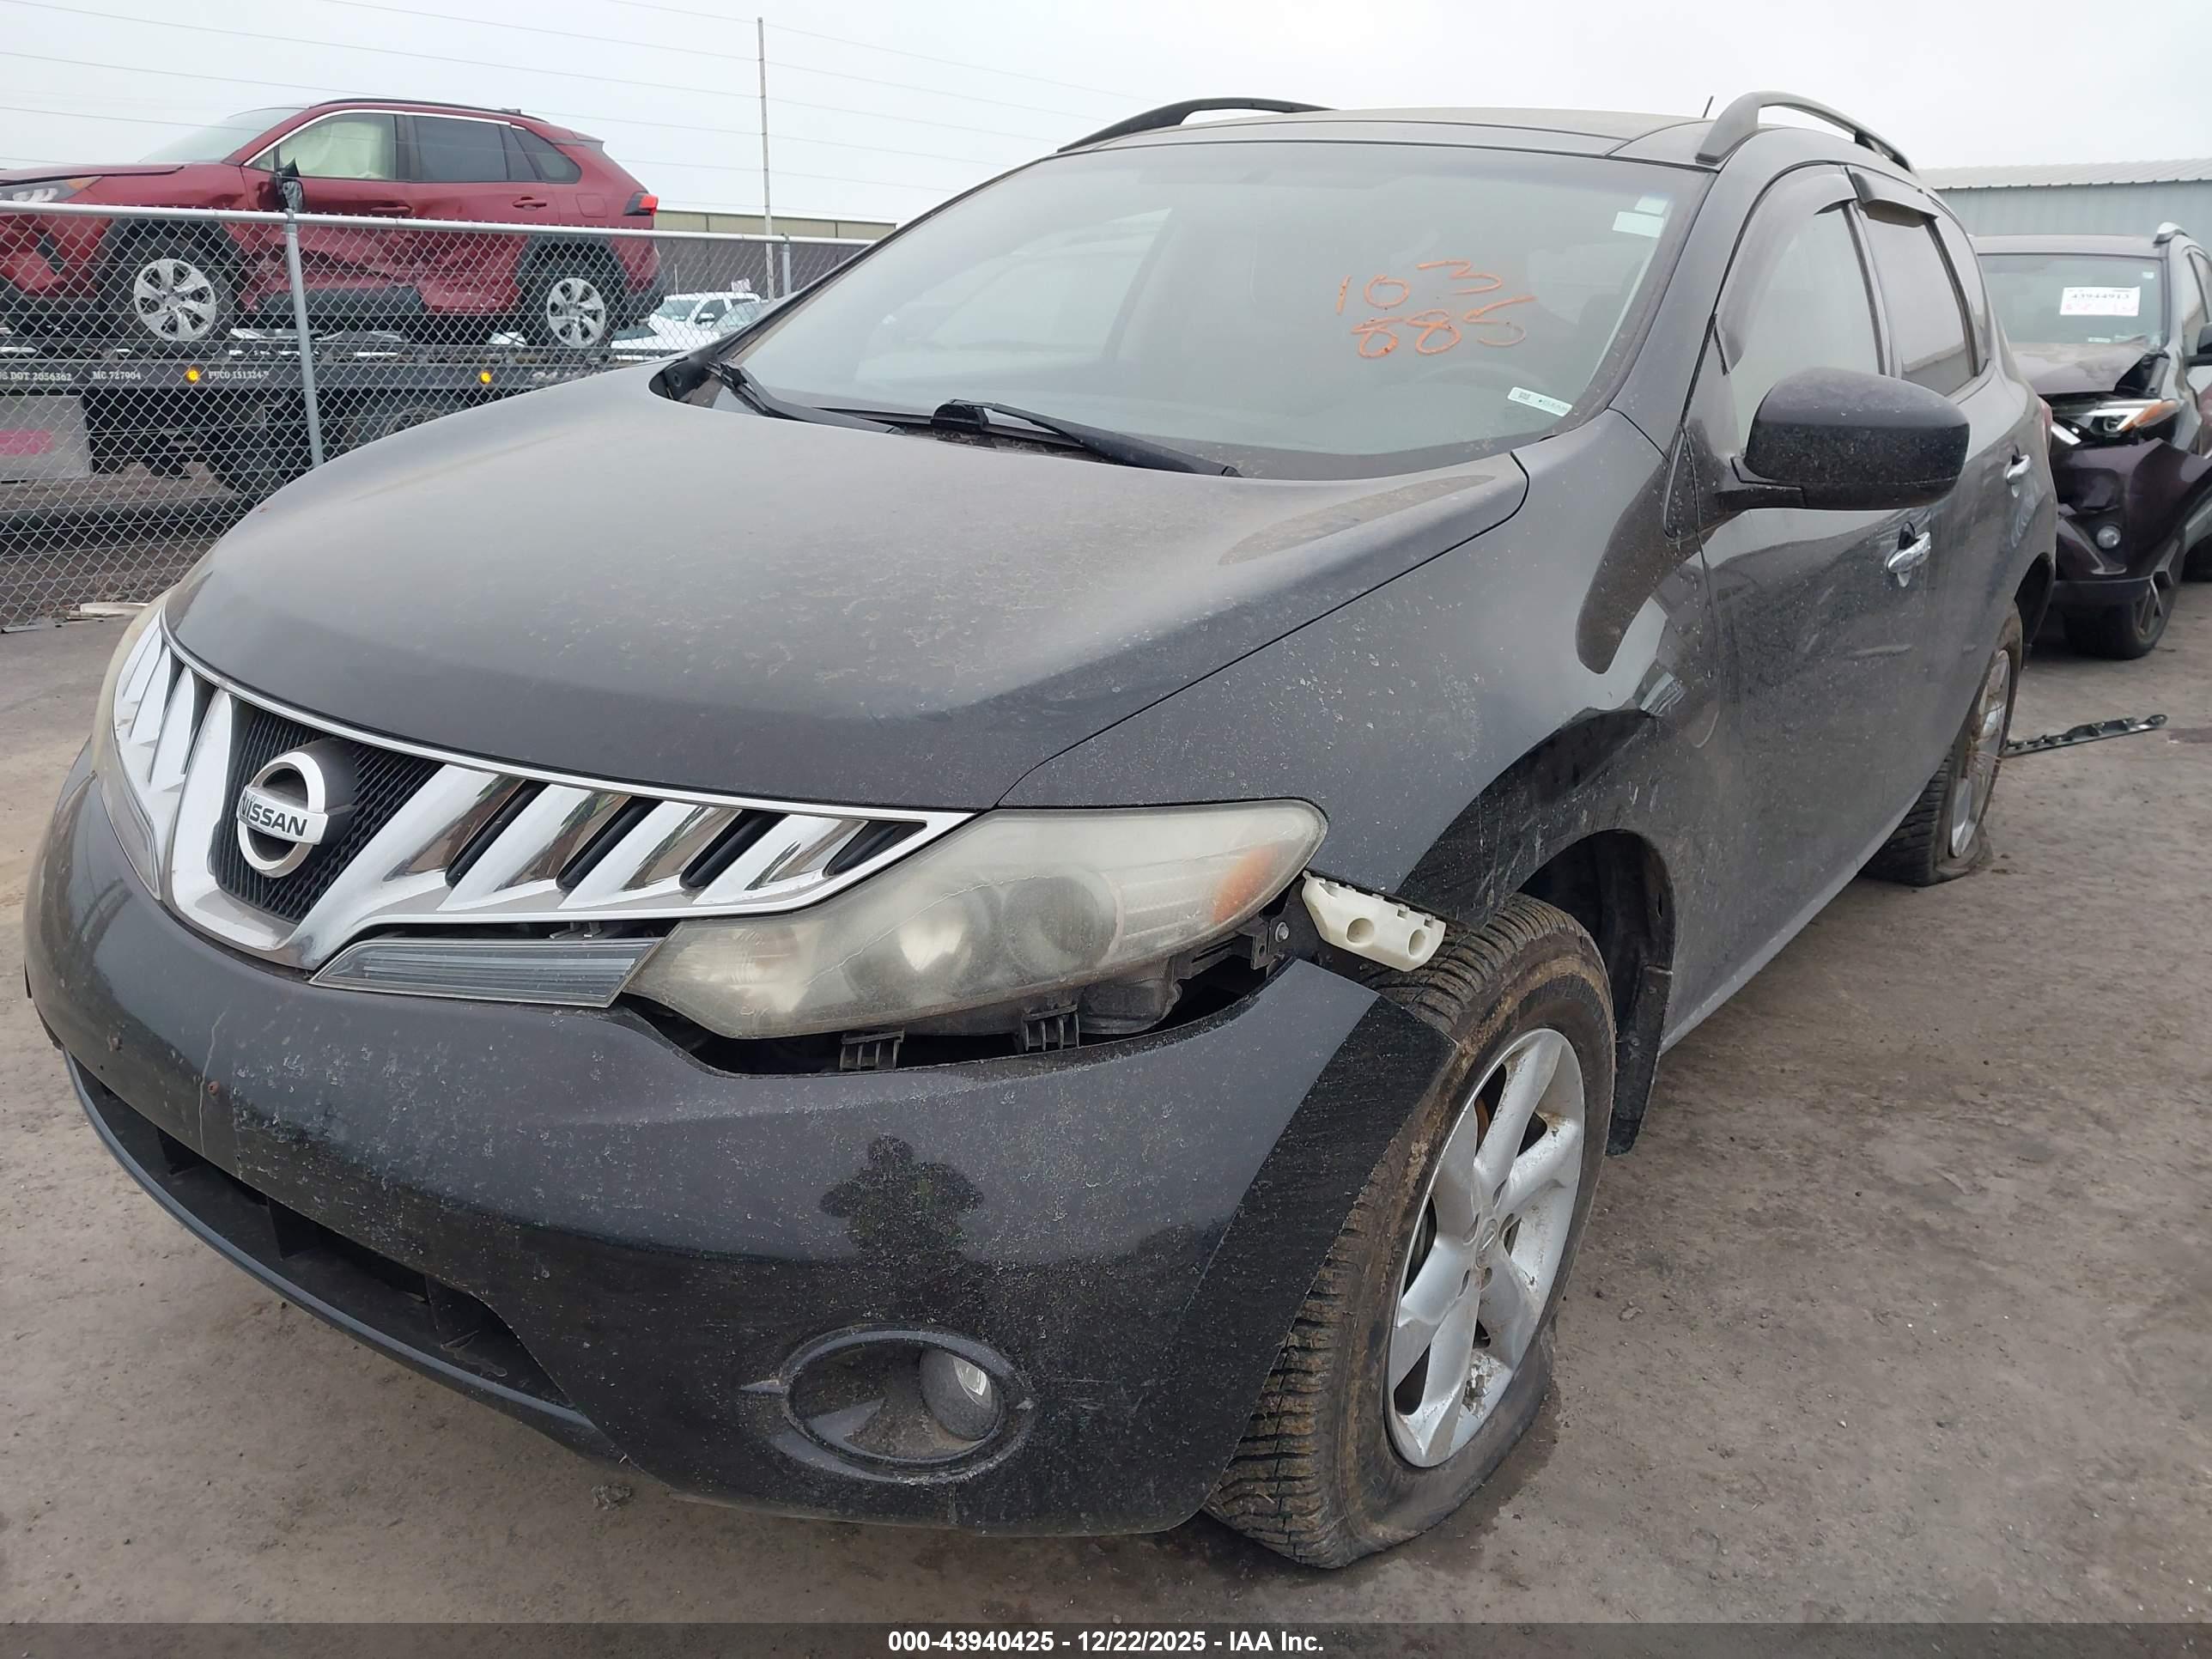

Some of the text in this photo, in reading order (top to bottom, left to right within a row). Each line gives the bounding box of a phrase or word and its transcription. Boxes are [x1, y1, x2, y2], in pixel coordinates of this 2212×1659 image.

[1334, 259, 1504, 315] 103
[10, 372, 31, 380] DOT
[92, 371, 109, 380] MC
[239, 795, 307, 837] NISSAN
